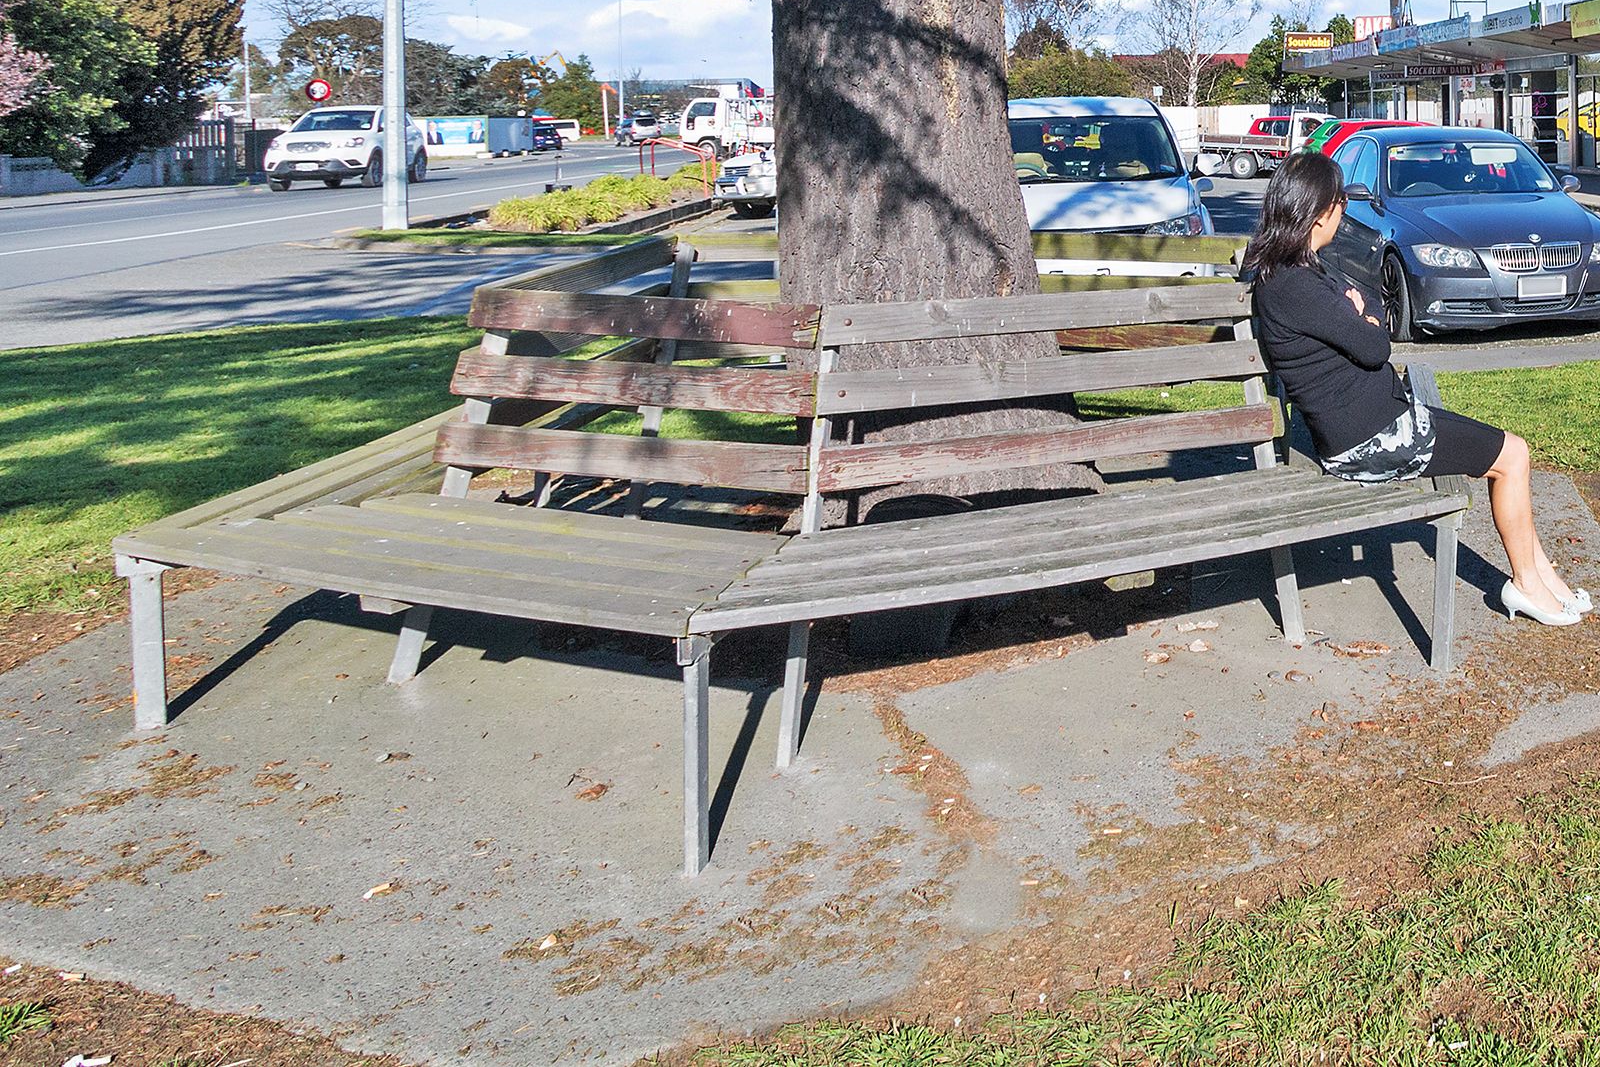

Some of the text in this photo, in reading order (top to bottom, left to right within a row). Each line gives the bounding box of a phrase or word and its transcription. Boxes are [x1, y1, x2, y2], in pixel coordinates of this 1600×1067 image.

[1356, 16, 1392, 40] BAKE
[1287, 35, 1331, 48] Souvlakis
[1408, 64, 1471, 76] SOCKBURN DAIRY
